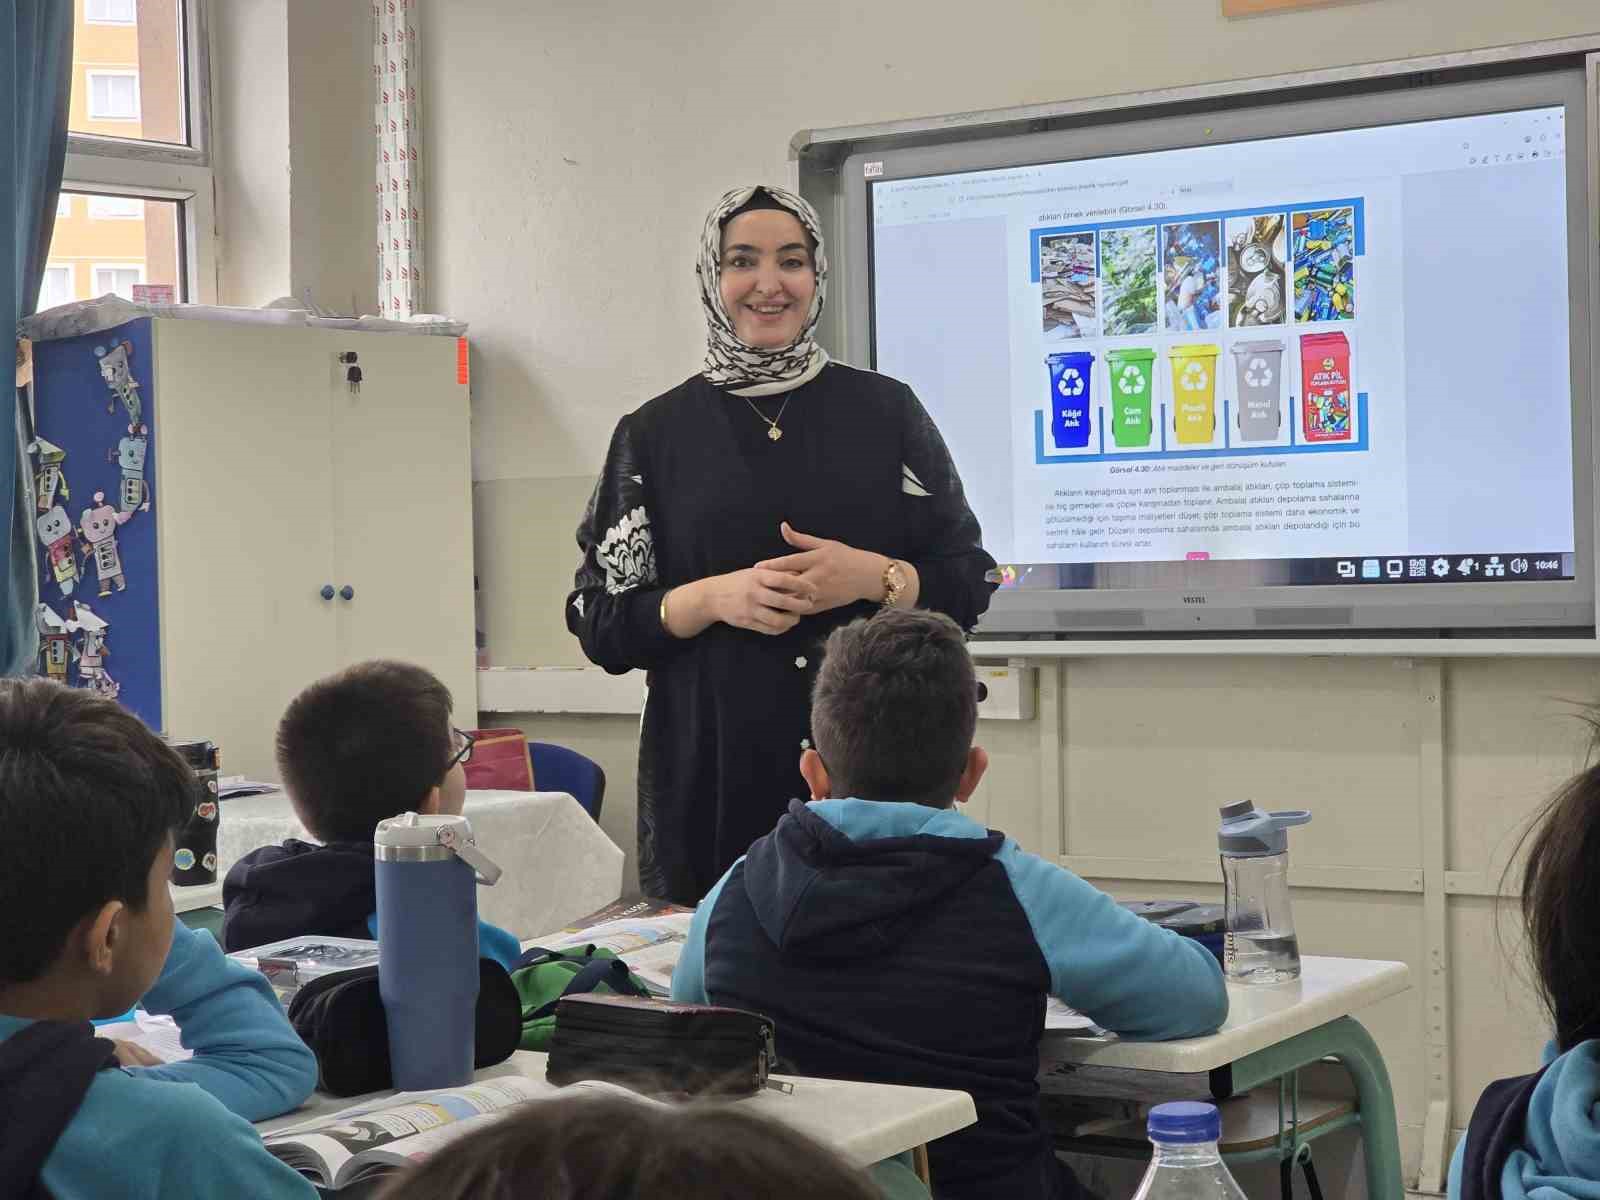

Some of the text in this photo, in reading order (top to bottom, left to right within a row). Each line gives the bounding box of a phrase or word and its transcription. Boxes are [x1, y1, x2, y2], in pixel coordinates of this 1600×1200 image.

[1124, 407, 1141, 415] Cam
[1110, 465, 1132, 474] Görsel
[1292, 480, 1326, 490] toplama
[1277, 495, 1316, 504] depolama
